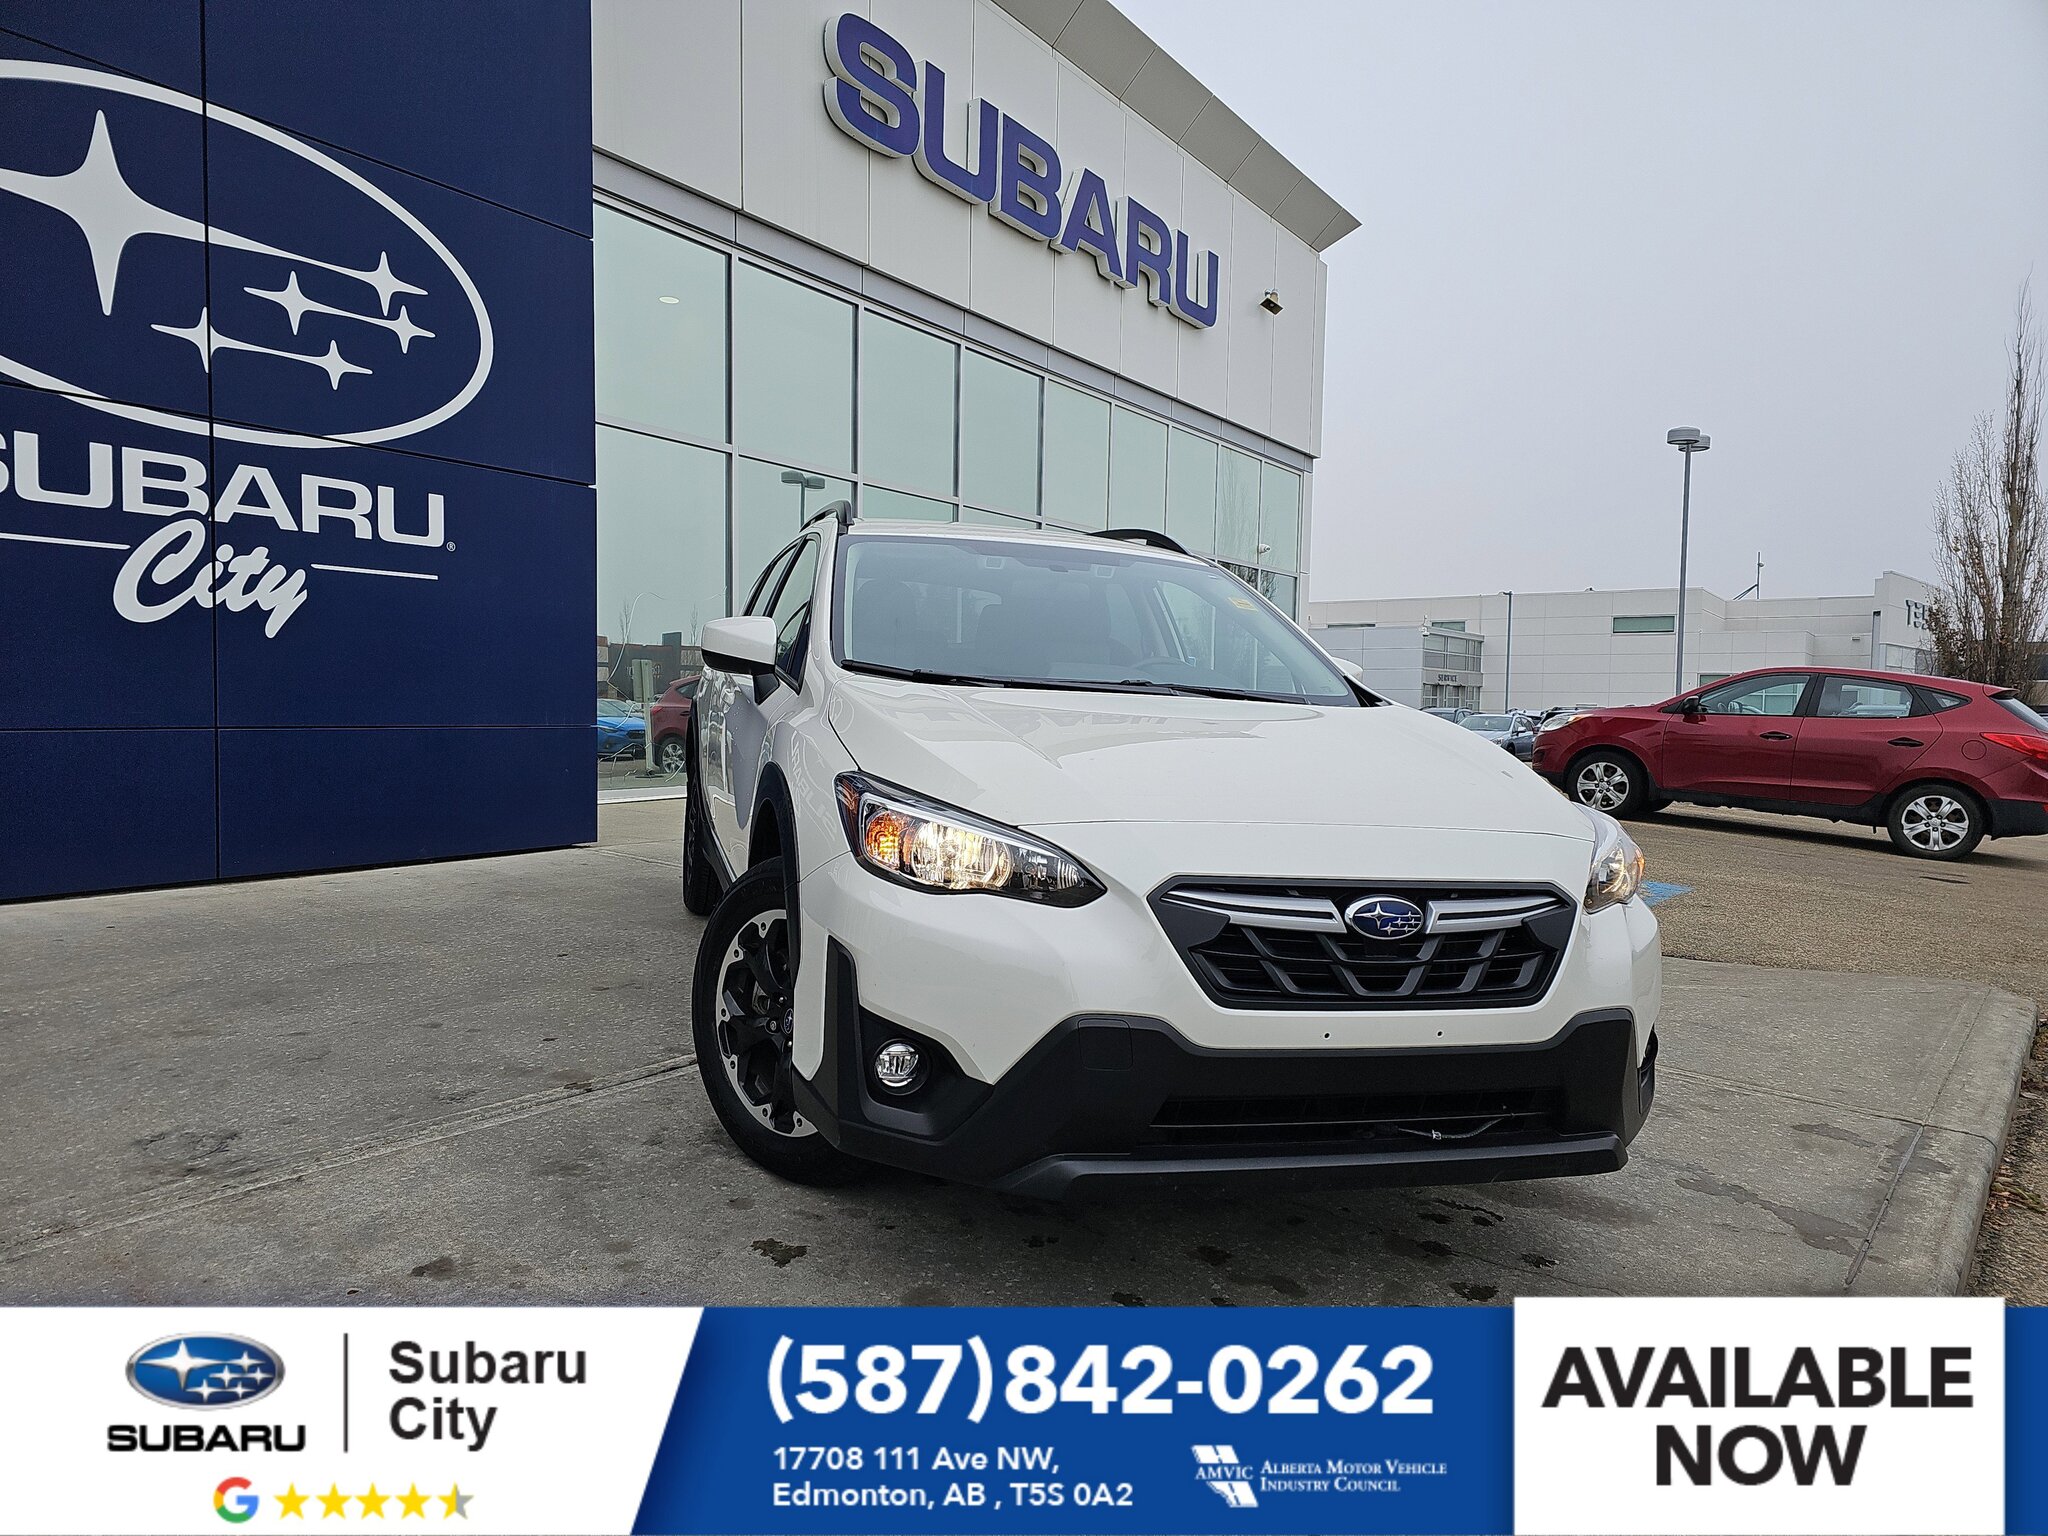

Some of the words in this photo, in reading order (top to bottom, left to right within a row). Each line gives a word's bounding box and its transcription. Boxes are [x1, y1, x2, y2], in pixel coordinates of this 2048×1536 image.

[823, 12, 1220, 329] SUBARU
[0, 430, 445, 548] UBARU
[112, 517, 309, 638] City
